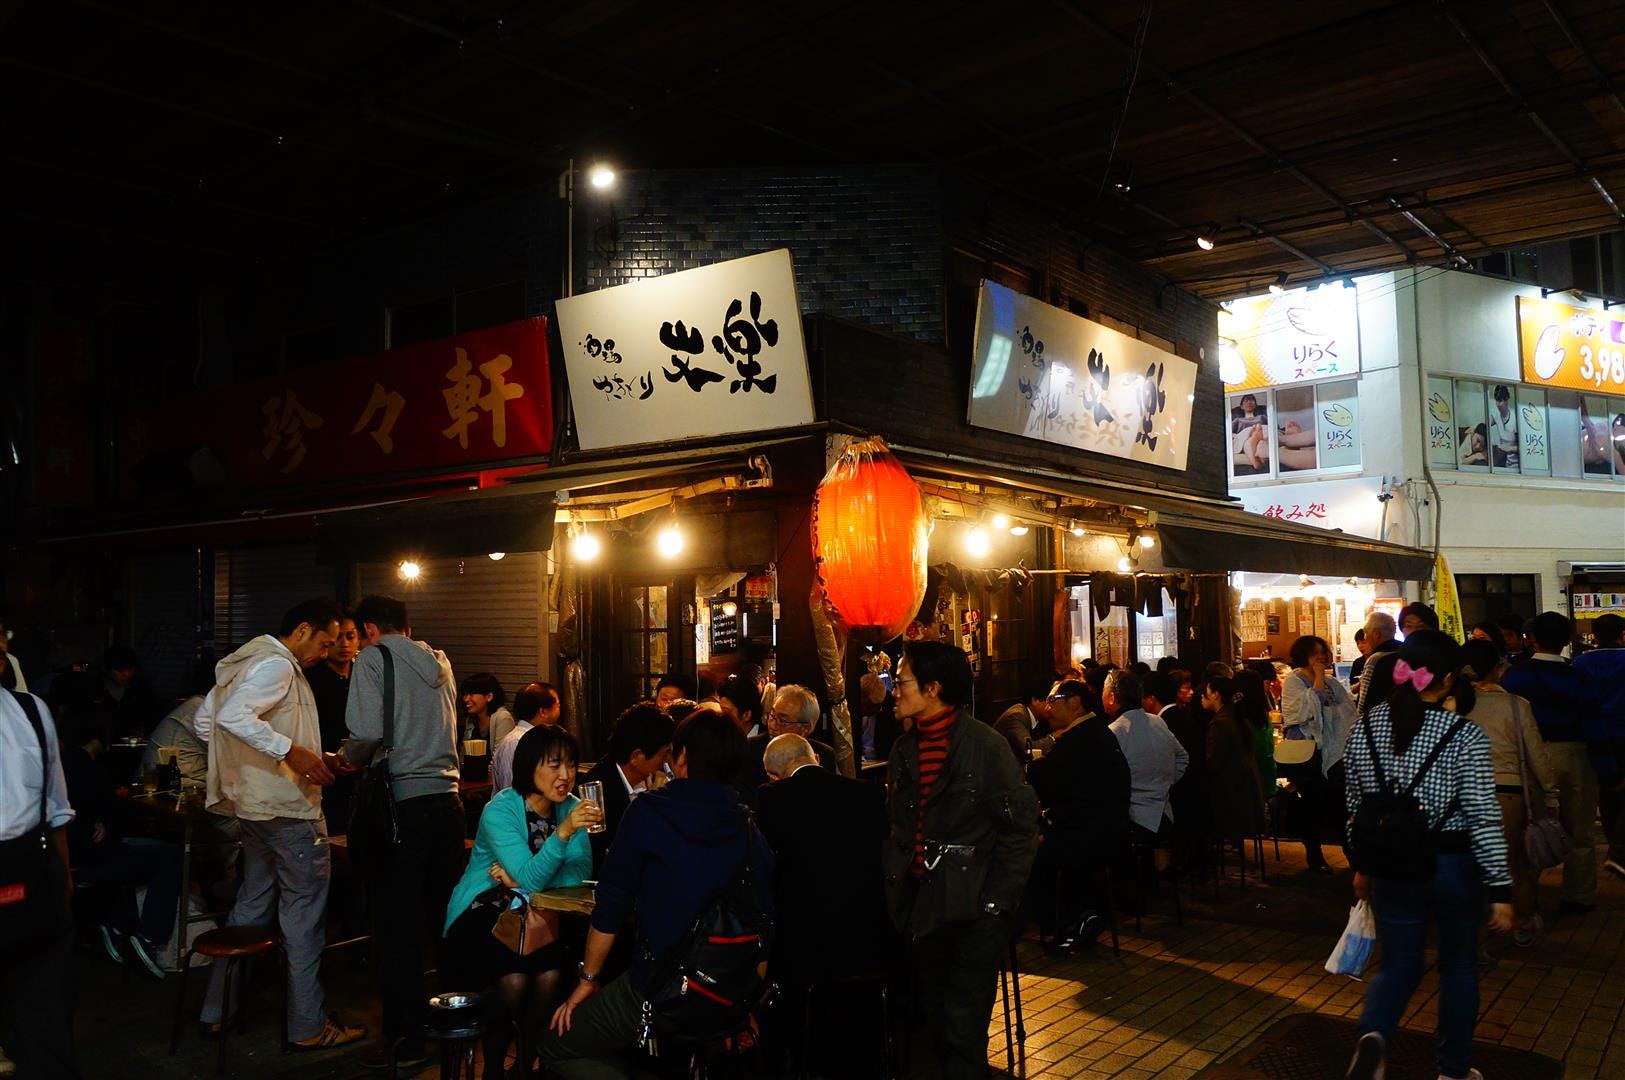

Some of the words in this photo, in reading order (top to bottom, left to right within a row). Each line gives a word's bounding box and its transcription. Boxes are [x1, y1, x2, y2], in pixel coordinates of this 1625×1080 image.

[1293, 340, 1338, 364] りらく
[1294, 363, 1339, 379] スペース
[261, 347, 524, 474] 珍々軒
[1327, 429, 1353, 443] りらく
[1430, 426, 1451, 440] りらく
[1526, 434, 1544, 447] りらく
[1327, 442, 1353, 450] スペース
[1263, 502, 1327, 520] 飲み処
